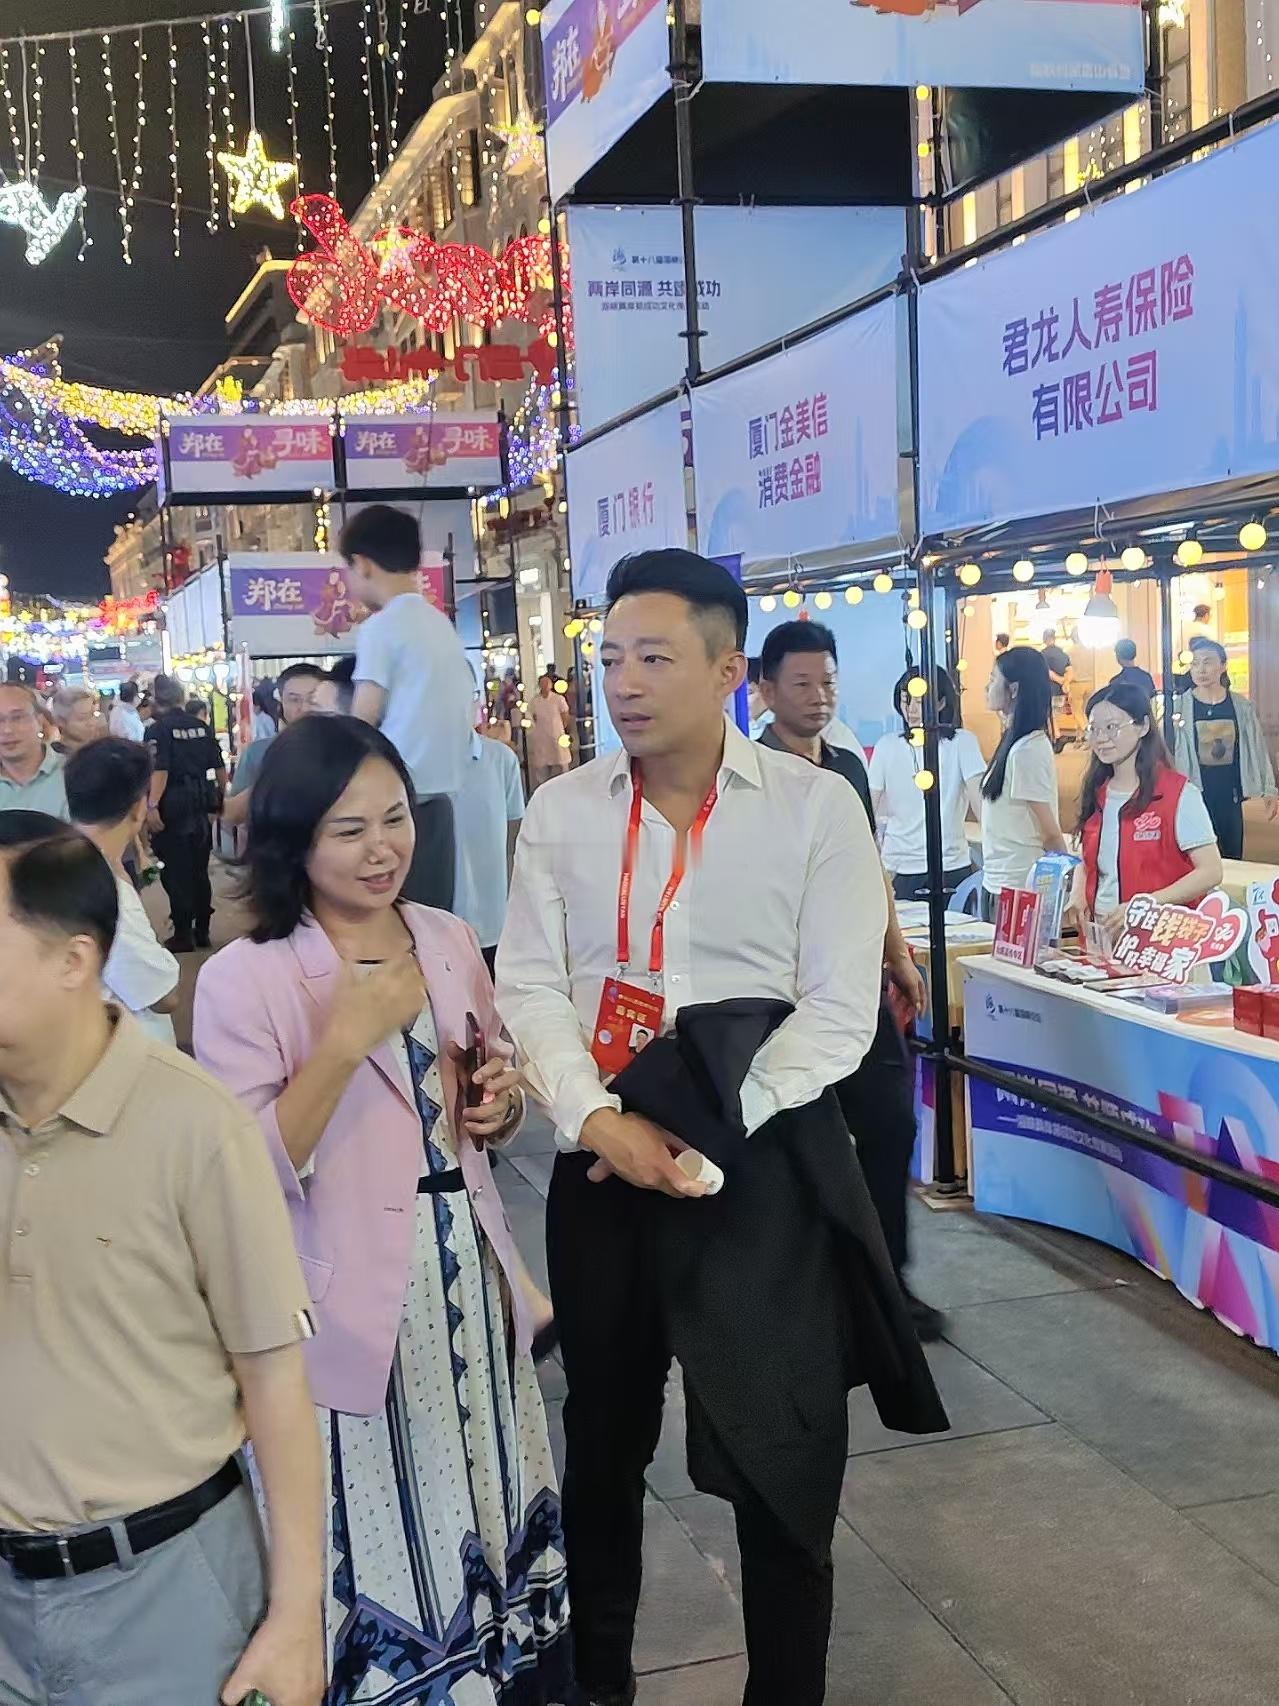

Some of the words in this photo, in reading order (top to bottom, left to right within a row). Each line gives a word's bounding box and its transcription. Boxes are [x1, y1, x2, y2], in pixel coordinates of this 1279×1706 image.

[1003, 254, 1193, 376] 君龙人寿保险
[1032, 350, 1157, 440] 有限公司
[179, 432, 225, 458] 郑在
[272, 428, 323, 457] 寻味
[355, 430, 397, 456] 郑在
[442, 426, 489, 453] 寻味
[749, 392, 828, 460] 厦门金美信
[759, 451, 821, 508] 消费金融
[244, 577, 303, 611] 郑在
[1127, 900, 1210, 946] 守住钱袋子
[1115, 933, 1196, 982] 护好幸福家
